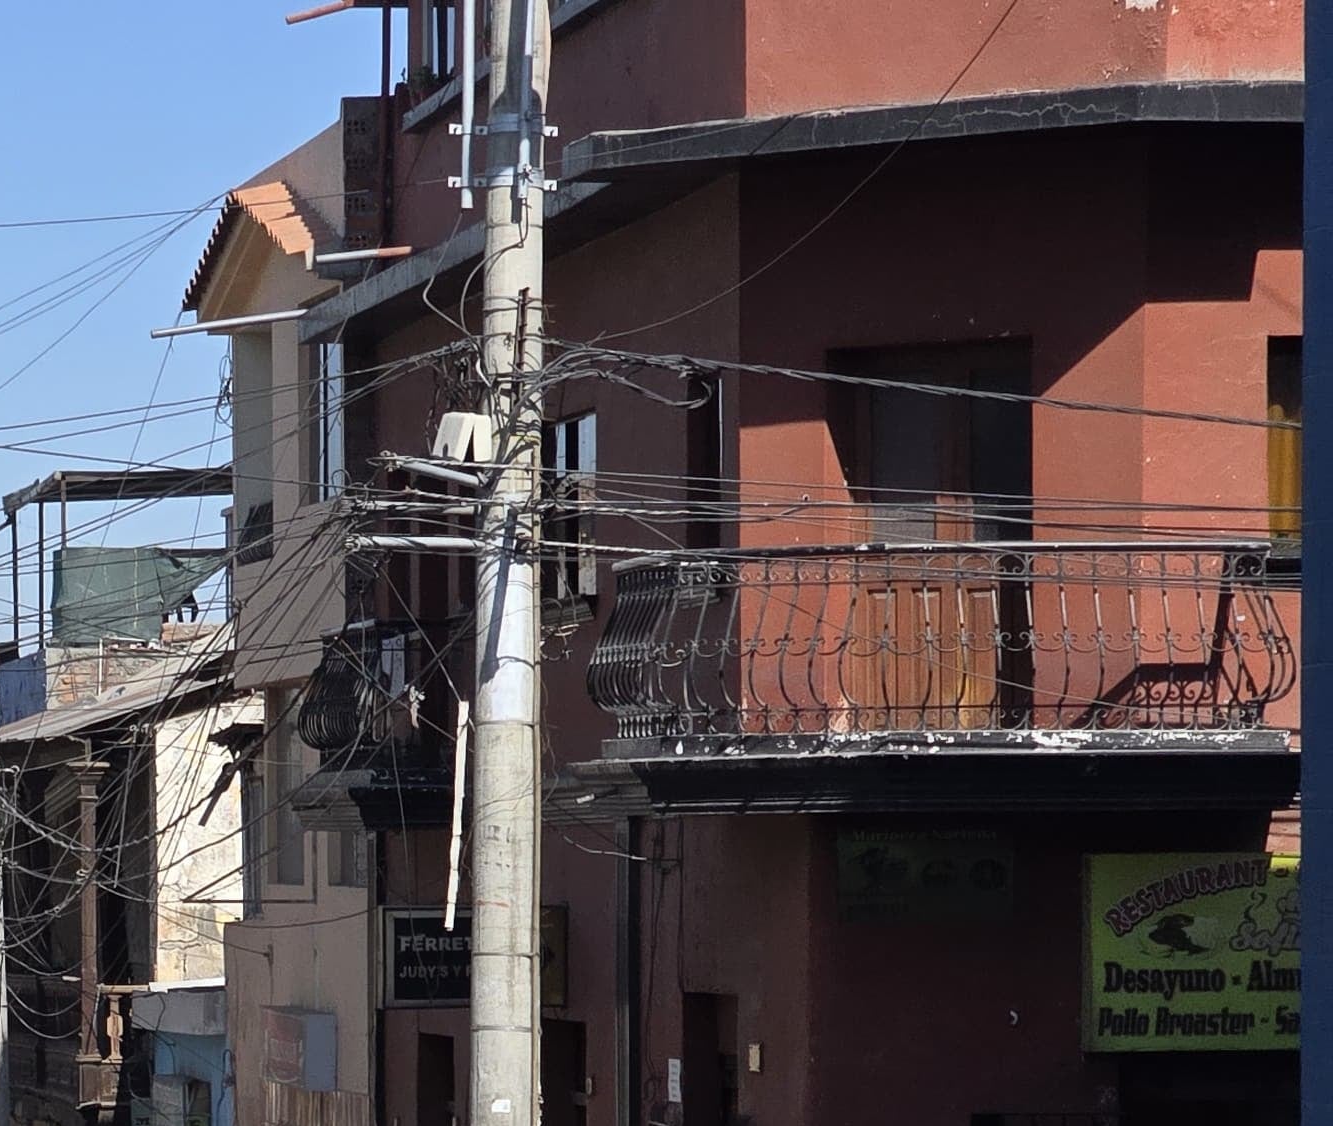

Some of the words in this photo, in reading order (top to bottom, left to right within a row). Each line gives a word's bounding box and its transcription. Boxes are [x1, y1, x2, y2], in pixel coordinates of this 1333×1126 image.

[1104, 859, 1267, 938] RESTAURANT
[1103, 961, 1226, 1001] Desayuno
[1098, 1007, 1150, 1036] Pollo
[1155, 1005, 1255, 1036] Broaster
